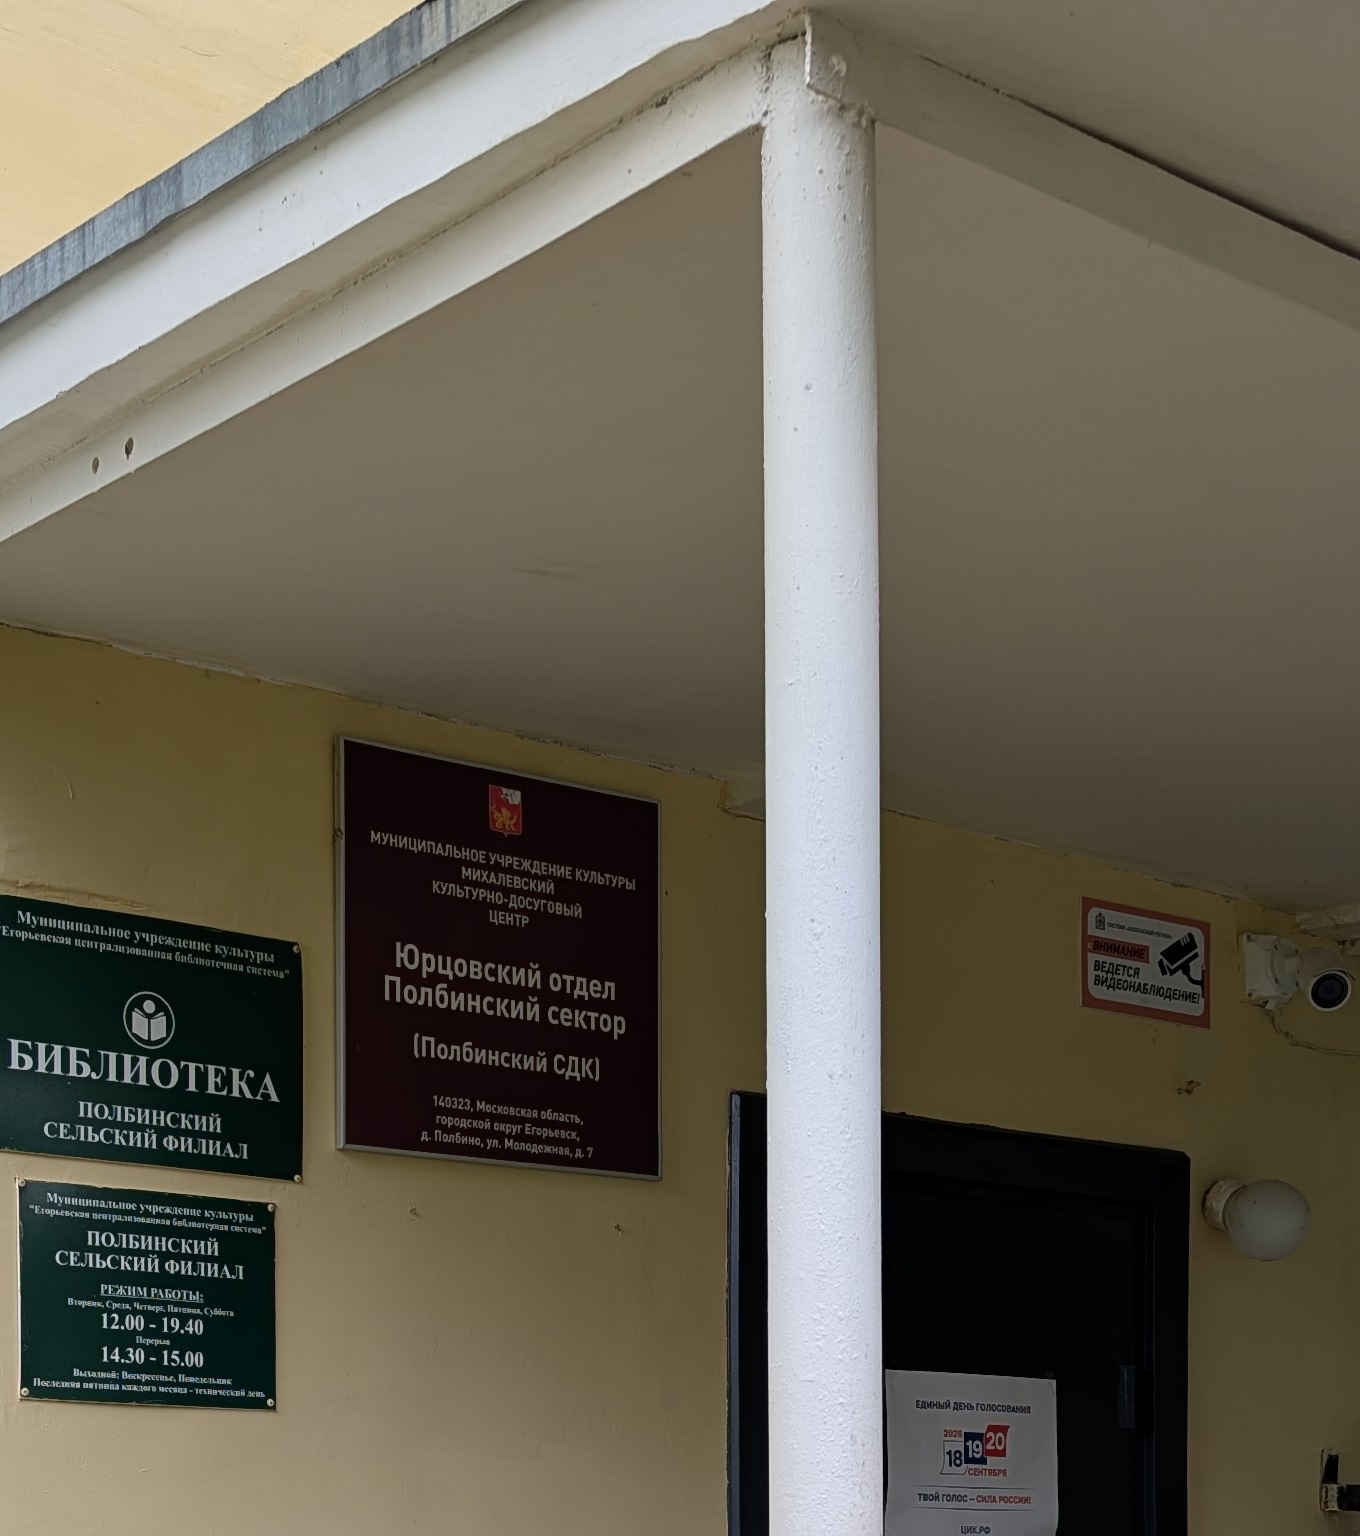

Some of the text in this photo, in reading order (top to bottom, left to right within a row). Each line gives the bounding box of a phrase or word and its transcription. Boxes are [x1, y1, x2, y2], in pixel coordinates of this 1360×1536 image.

[370, 830, 636, 891] МУНИЦИПАЛЬНОЕ УЧРЕЖДЕНИЕ КУЛЬТУРЫ
[462, 866, 555, 894] МИХАЛЕВСКИЙ
[432, 880, 583, 919] КУЛЬТУРНО-ДОСУГОВЫЙ
[489, 909, 530, 928] ЦЕНТР
[17, 910, 274, 963] Муниципальное учреждение культуры
[1093, 940, 1145, 959] ВНИМАНИЕ
[74, 938, 172, 961] централизованная
[175, 952, 243, 972] библиотечная
[1094, 960, 1140, 979] ВЕДЕТСЯ
[395, 941, 616, 1001] Юрцовский отдел
[1094, 975, 1200, 1004] ВИДЕОНАБЛЮДЕНИЕ!
[384, 975, 626, 1040] Полбинский сектор
[7, 1038, 281, 1103] БИБЛИОТЕКА
[413, 1033, 601, 1082] (Полбинский СДК)
[78, 1101, 222, 1134] ПОЛБИНСКИЙ
[433, 1095, 584, 1126] 140323, Московская область,
[43, 1121, 249, 1159] СЕЛЬСКИЙ ФИЛИАЛ
[436, 1114, 581, 1141] городской округ Егорьевск,
[434, 1131, 485, 1149] Полбино,
[487, 1138, 502, 1150] ул.
[504, 1139, 573, 1158] Молодежная,
[587, 1147, 594, 1158] 7
[46, 1192, 254, 1223] Муниципальное учреждение культуры
[87, 1231, 219, 1257] ПОЛБИНСКИЙ
[55, 1251, 244, 1280] СЕЛЬСКИЙ ФИЛИАЛ
[100, 1284, 204, 1302] РЕЖИМ РАБОТЫ:
[101, 1314, 144, 1331] 12.00
[162, 1317, 203, 1335] 19.40
[101, 1347, 144, 1363] 14.30
[162, 1351, 203, 1367] 15.00
[916, 1399, 1031, 1414] ЕДИНЫЙ ДЕНЬ ГОЛОСОВАНИЯ
[946, 1432, 1004, 1467] 18 19 20
[968, 1468, 1007, 1477] СЕНТЯБРЯ
[918, 1492, 939, 1502] ТВОЙ
[942, 1494, 968, 1502] ГОЛОС
[976, 1495, 996, 1503] СИЛА
